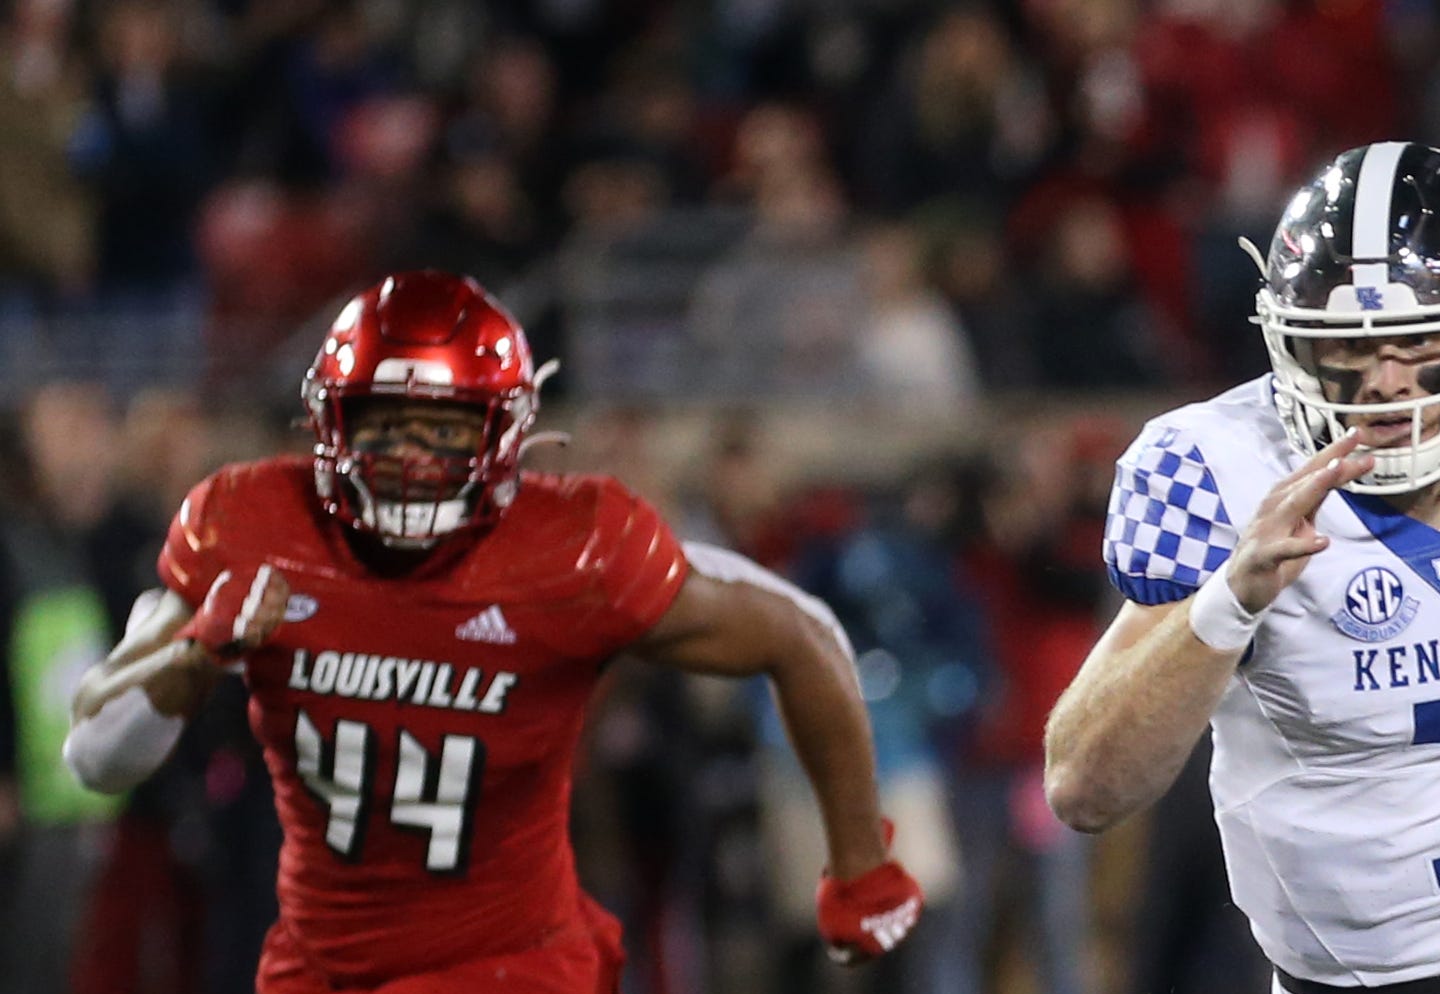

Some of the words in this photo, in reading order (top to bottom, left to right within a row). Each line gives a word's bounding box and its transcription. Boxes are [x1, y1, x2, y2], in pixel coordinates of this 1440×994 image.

[1346, 567, 1402, 625] SEC
[289, 648, 518, 713] LOUISVILLE
[294, 709, 477, 871] 44
